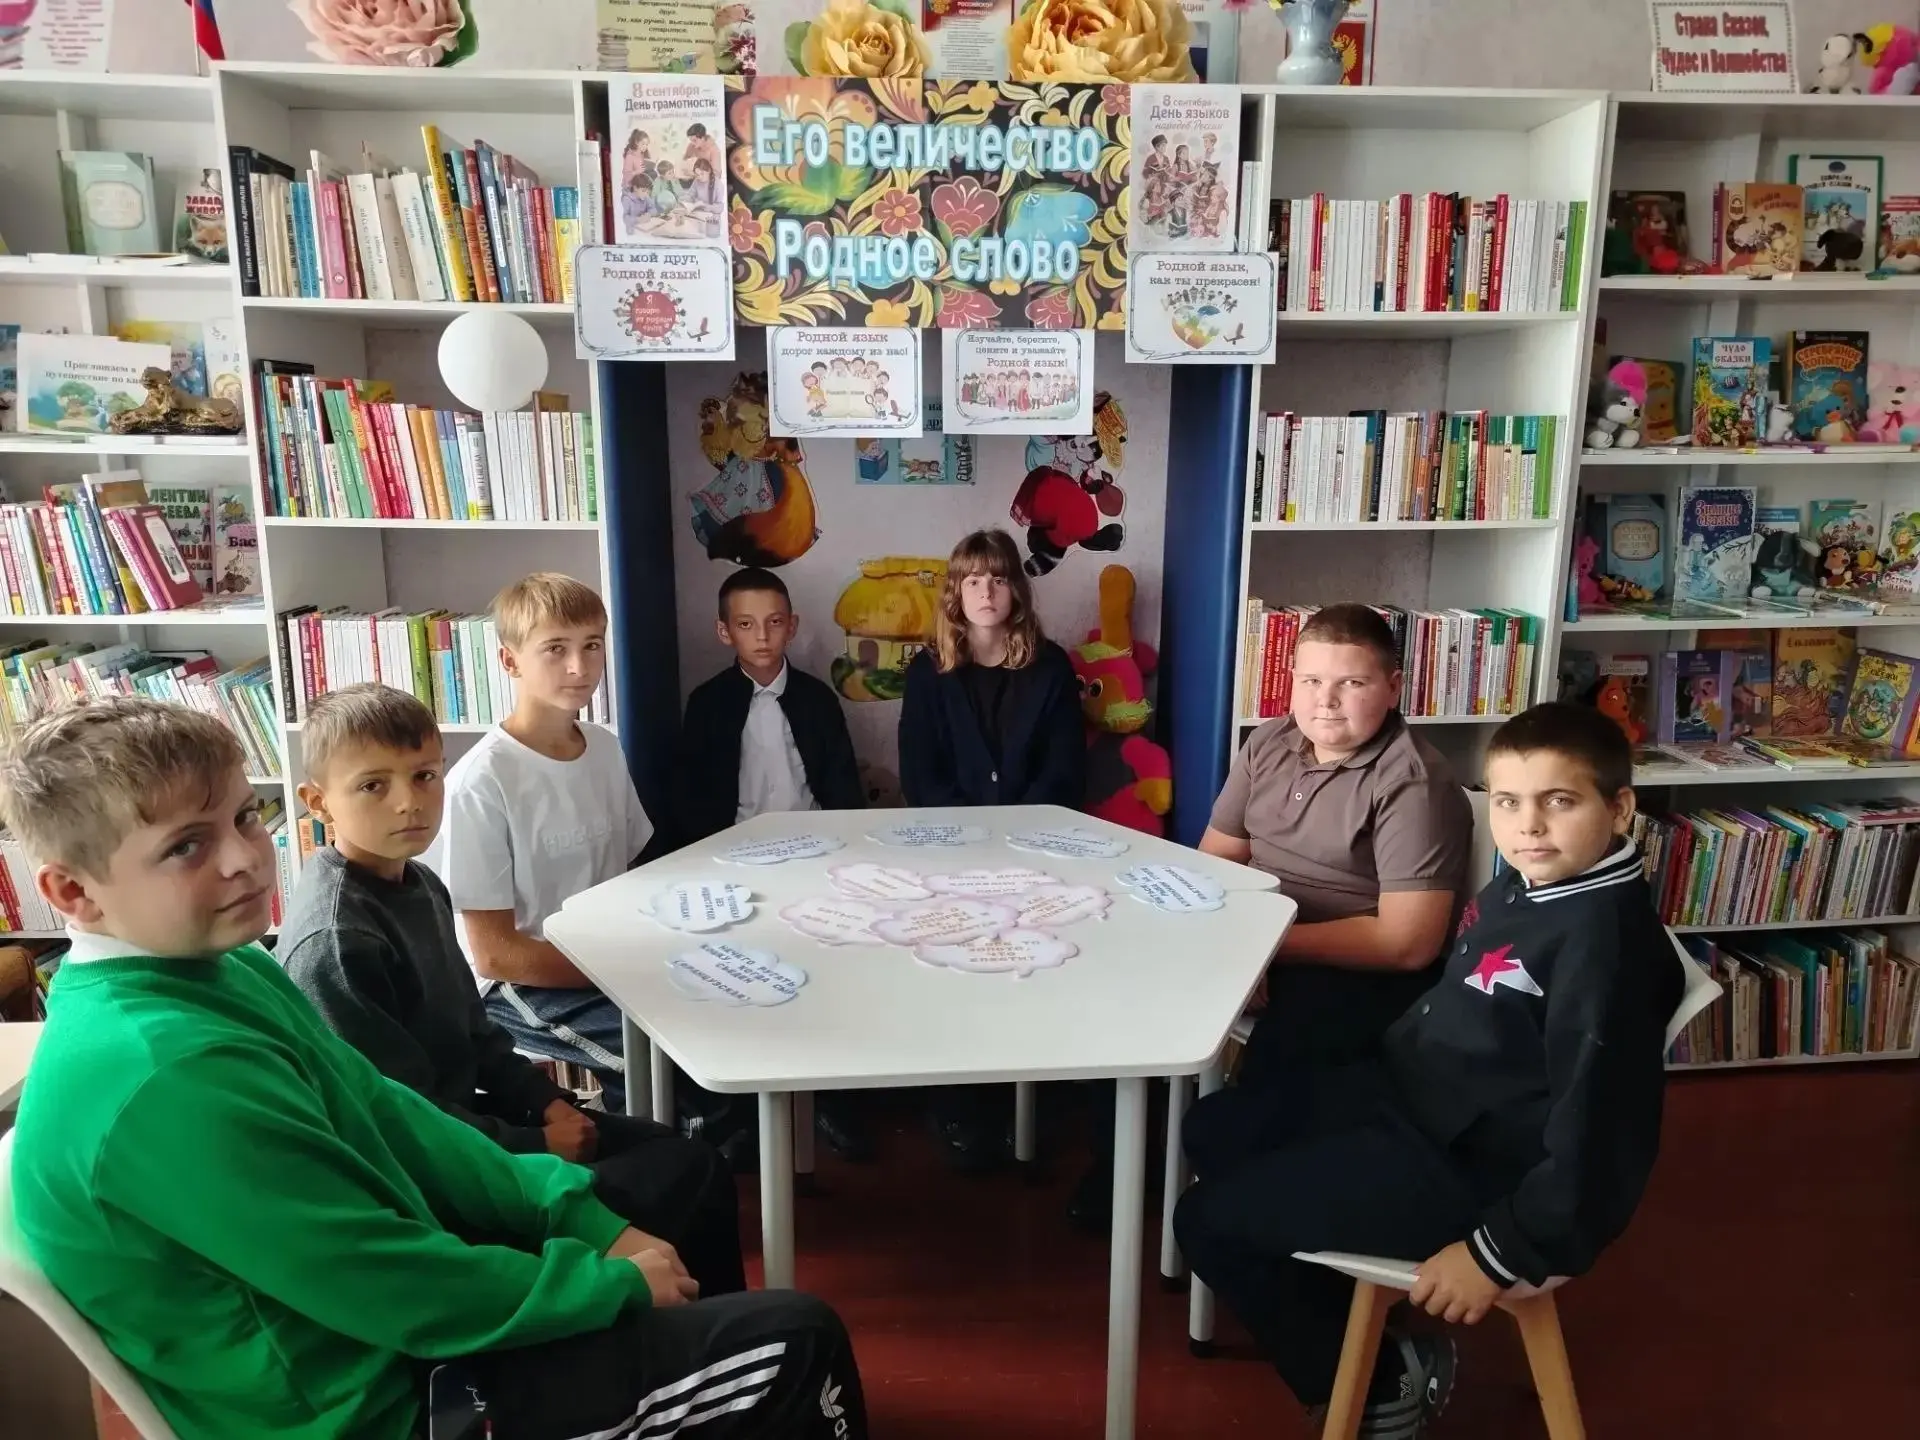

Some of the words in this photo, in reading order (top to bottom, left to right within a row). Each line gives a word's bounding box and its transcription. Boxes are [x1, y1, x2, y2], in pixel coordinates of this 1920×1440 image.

[632, 82, 643, 98] 8
[646, 84, 700, 100] сентября
[624, 98, 651, 112] День
[653, 99, 718, 111] грамотности:
[1162, 94, 1172, 106] 8
[1150, 105, 1182, 120] День
[1186, 109, 1230, 119] языков
[753, 104, 830, 168] Его
[843, 120, 1103, 173] величество
[186, 206, 223, 215] ЖИВОТ
[602, 251, 624, 263] Ты
[630, 252, 658, 263] мой
[664, 254, 700, 266] друг,
[775, 218, 938, 289] Родное
[950, 236, 1081, 282] слово
[602, 267, 655, 280] Родной
[660, 269, 702, 280] язык!
[1156, 260, 1206, 273] Родной
[1210, 262, 1250, 274] язык,
[1150, 277, 1172, 285] как
[1174, 278, 1191, 286] ты
[1195, 277, 1261, 288] прекрасен!
[646, 294, 653, 305] Я
[798, 331, 848, 344] Родной
[852, 332, 888, 342] язык
[967, 334, 1014, 344] Изучайте,
[1017, 335, 1060, 345] берегите,
[781, 348, 812, 358] дорог
[816, 348, 866, 358] каждому
[870, 348, 882, 356] из
[886, 348, 908, 356] нас!
[976, 346, 1008, 354] цените
[1021, 346, 1066, 355] уважайте
[1721, 344, 1746, 352] ЧУДО
[987, 358, 1030, 368] Родной
[1034, 358, 1068, 368] язык!
[1714, 355, 1751, 364] СКАЗКИ
[112, 376, 124, 384] по
[150, 488, 209, 504] ЛЕНТИН
[160, 504, 200, 519] СЕЕВА
[228, 536, 256, 548] Бас
[718, 944, 756, 966] НИЧЕГО
[758, 966, 796, 988] РУГАТЬ
[738, 965, 770, 983] КОГДА
